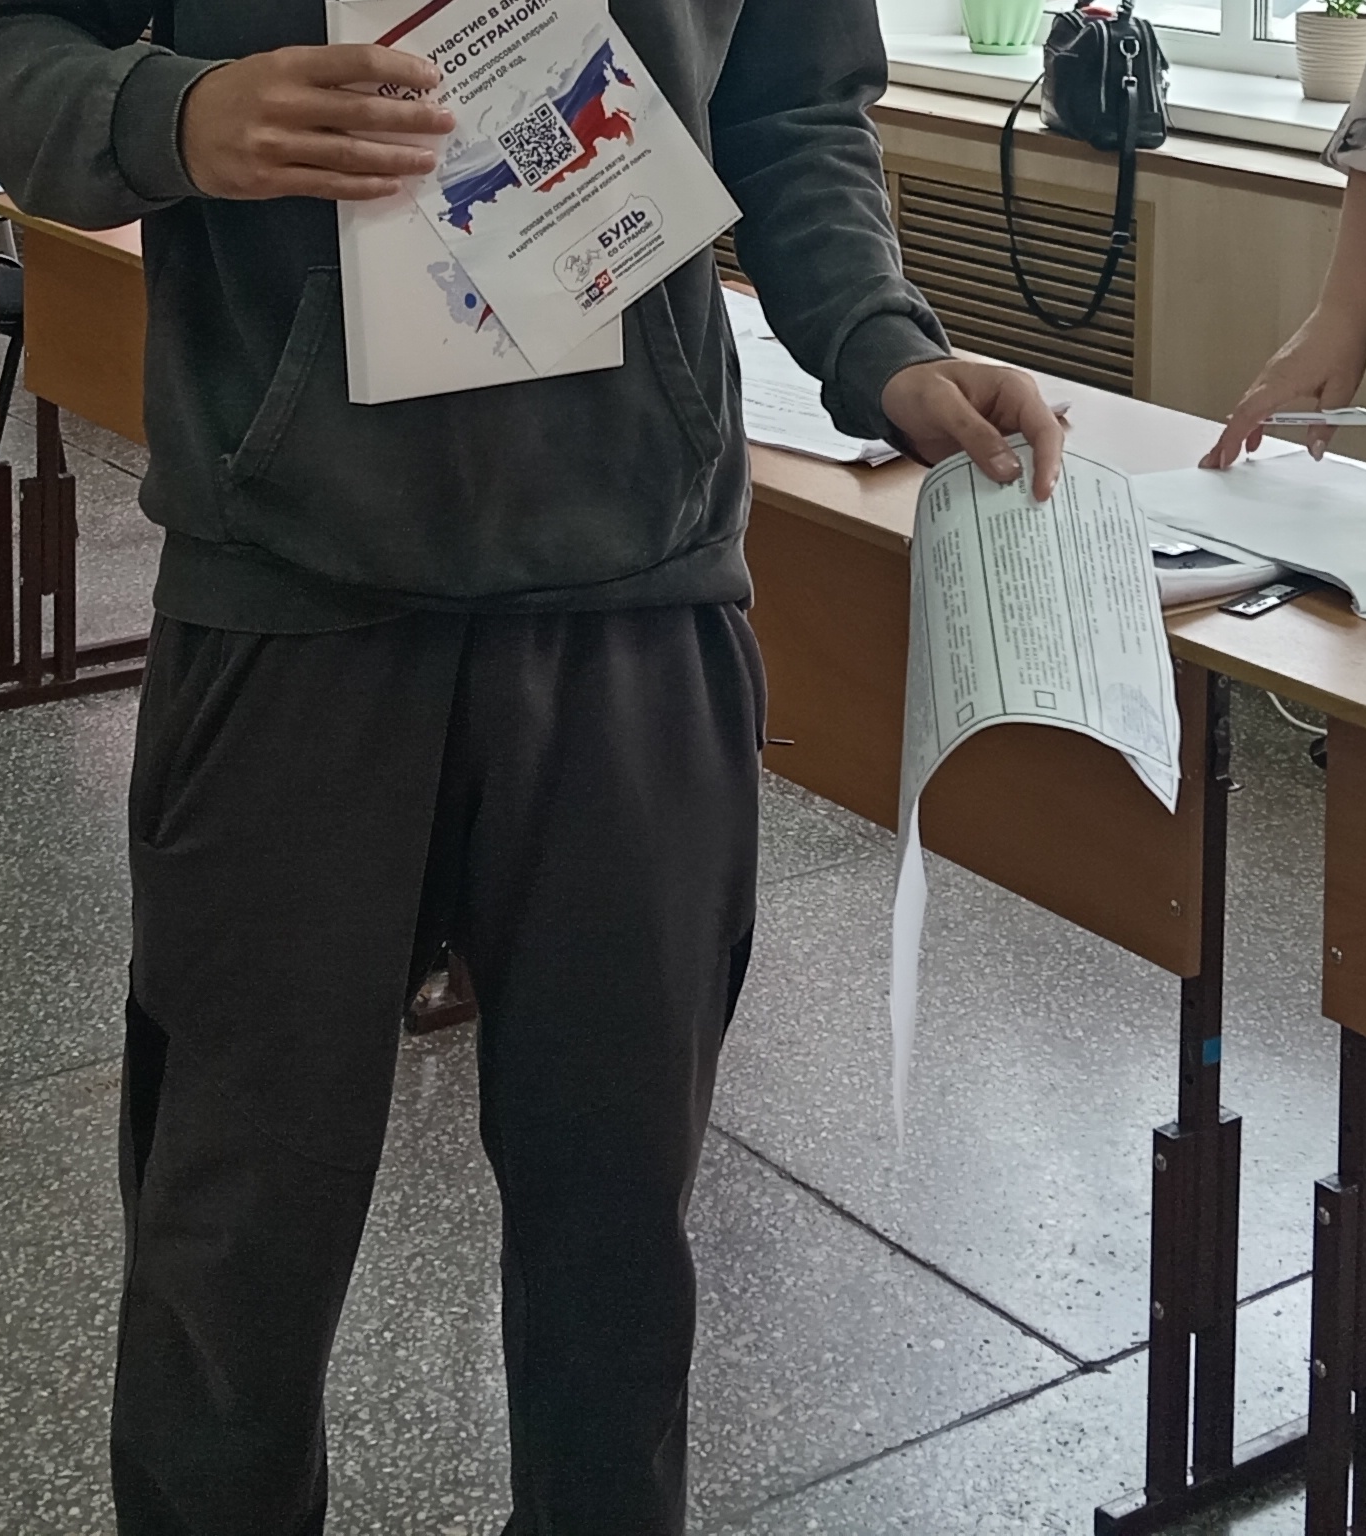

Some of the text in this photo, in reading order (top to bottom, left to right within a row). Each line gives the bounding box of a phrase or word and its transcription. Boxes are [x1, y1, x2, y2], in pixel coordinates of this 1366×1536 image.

[427, 15, 488, 65] участие
[487, 7, 500, 19] в
[459, 78, 470, 91] ты
[469, 39, 523, 82] проголосовал
[521, 11, 559, 44] впервые?
[443, 53, 468, 75] СО
[459, 73, 497, 105] Сканируй
[597, 210, 646, 249] БУДЬ
[607, 247, 619, 258] СО
[589, 288, 601, 299] 19
[596, 274, 610, 288] 20
